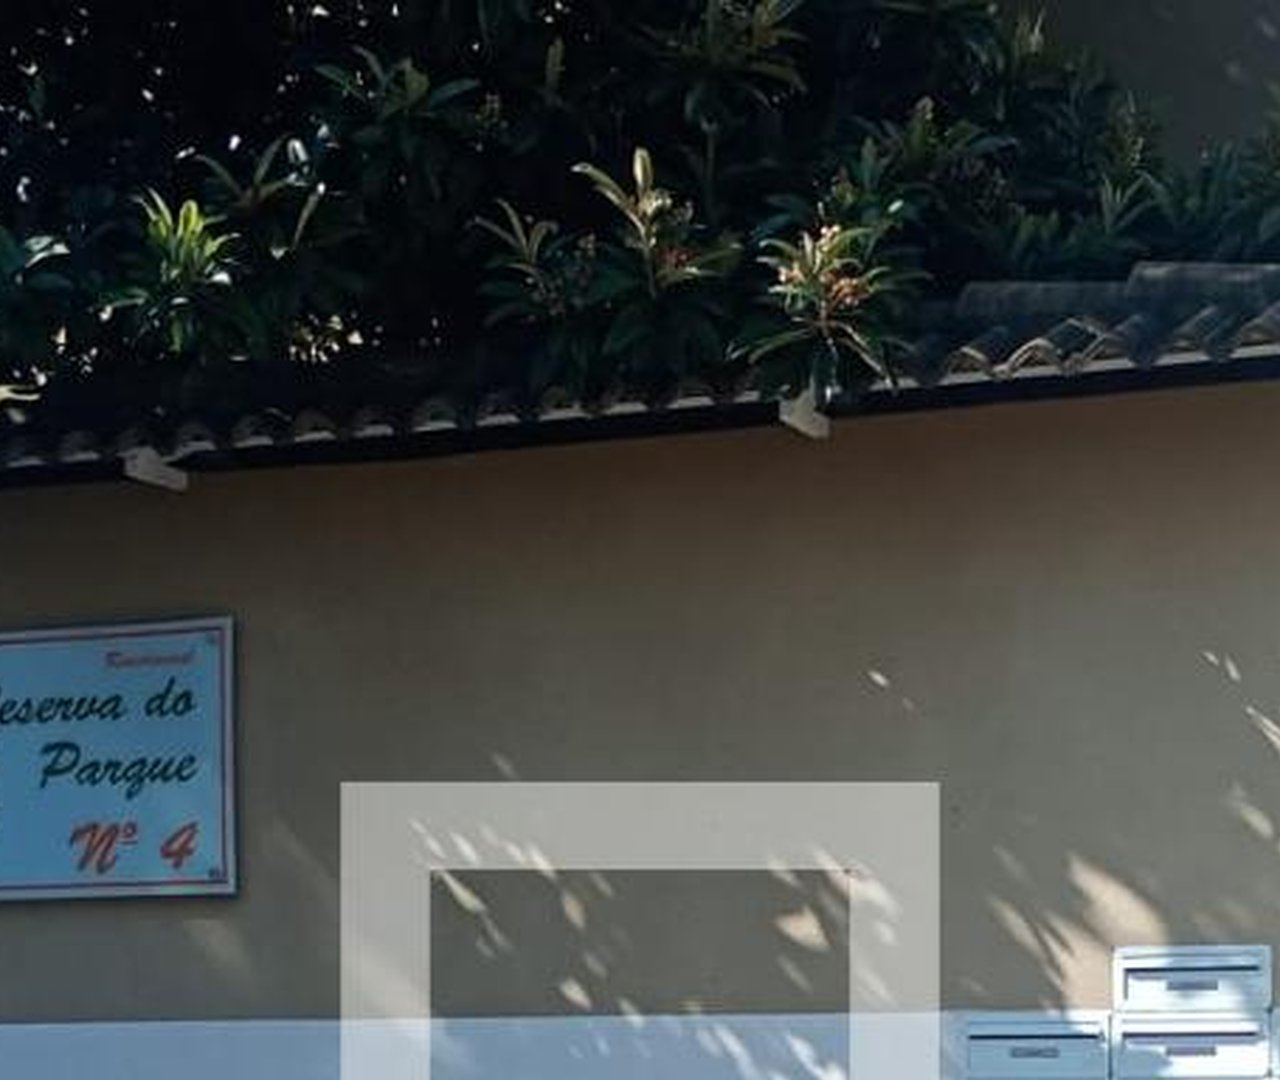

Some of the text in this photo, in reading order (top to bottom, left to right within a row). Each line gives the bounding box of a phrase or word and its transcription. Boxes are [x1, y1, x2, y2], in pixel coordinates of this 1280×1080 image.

[144, 676, 197, 717] do
[39, 740, 198, 799] Parque
[159, 820, 198, 870] 4
